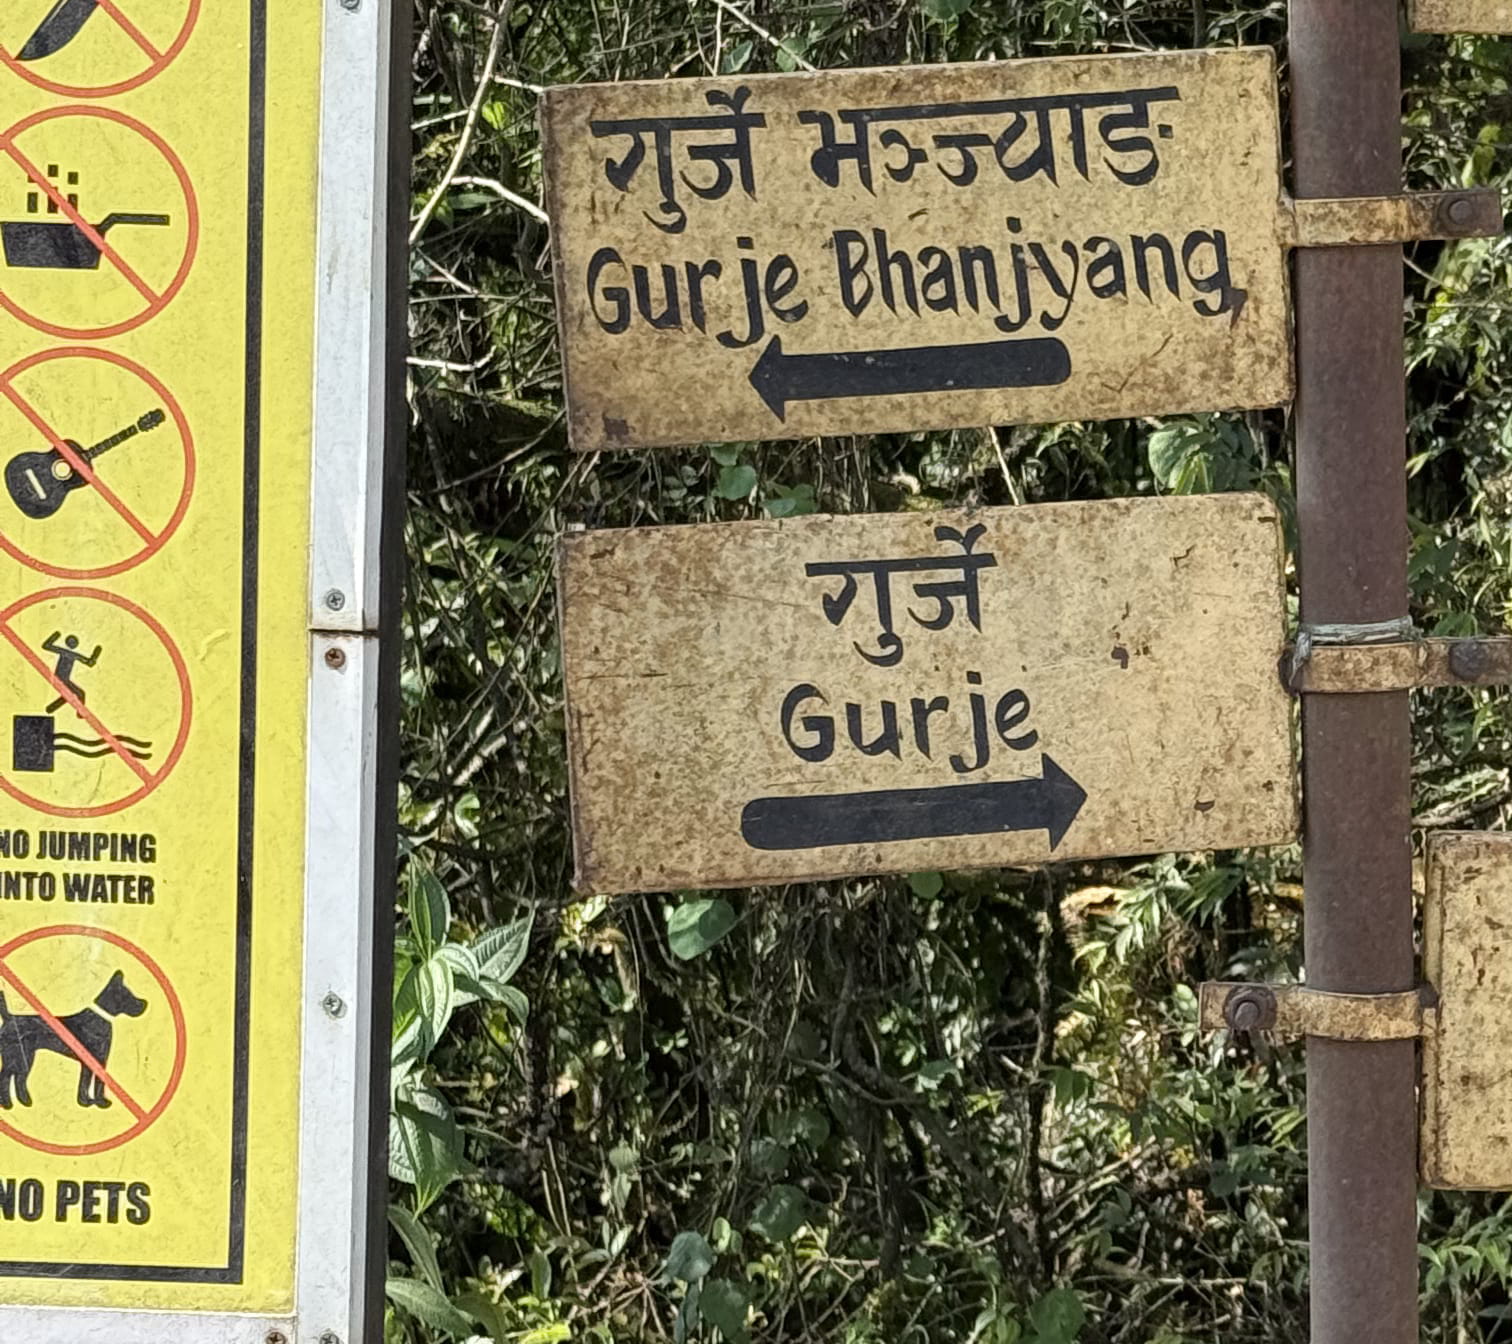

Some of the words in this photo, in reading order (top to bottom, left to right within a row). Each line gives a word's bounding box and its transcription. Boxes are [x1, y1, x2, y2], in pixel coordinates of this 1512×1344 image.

[590, 86, 767, 234] गुर्जे
[586, 236, 808, 348] Gurje
[804, 523, 998, 667] गुर्जे
[780, 671, 1040, 774] Gurje
[36, 830, 157, 864] JUMPING
[63, 872, 155, 905] WATER
[0, 1178, 44, 1223] NO
[55, 1179, 151, 1226] PETS
